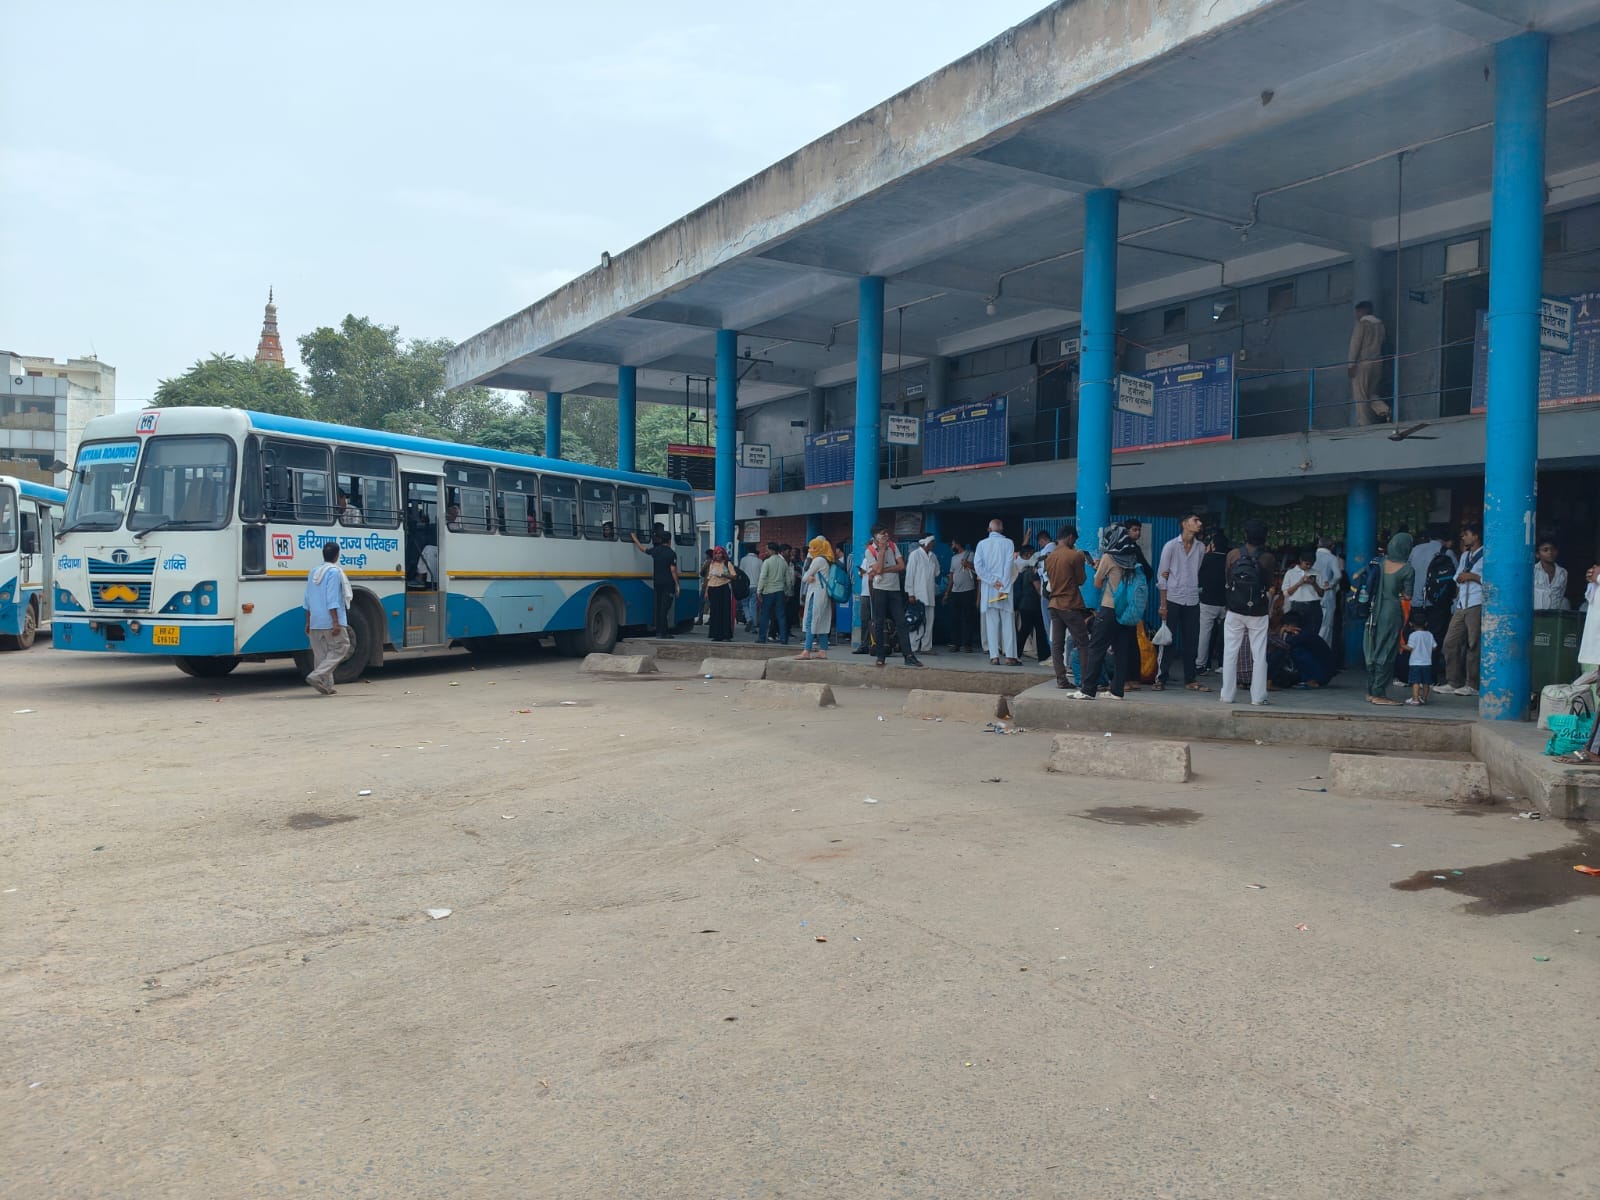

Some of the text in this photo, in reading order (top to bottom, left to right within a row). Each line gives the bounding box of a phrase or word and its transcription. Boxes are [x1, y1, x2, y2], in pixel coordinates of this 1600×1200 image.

[103, 446, 138, 459] ROADWAYS
[339, 536, 362, 550] राज्य
[364, 532, 398, 552] परिवहन
[57, 555, 81, 570] हरियाणा
[163, 553, 187, 571] शक्ति
[340, 553, 367, 569] रेवाड़ी
